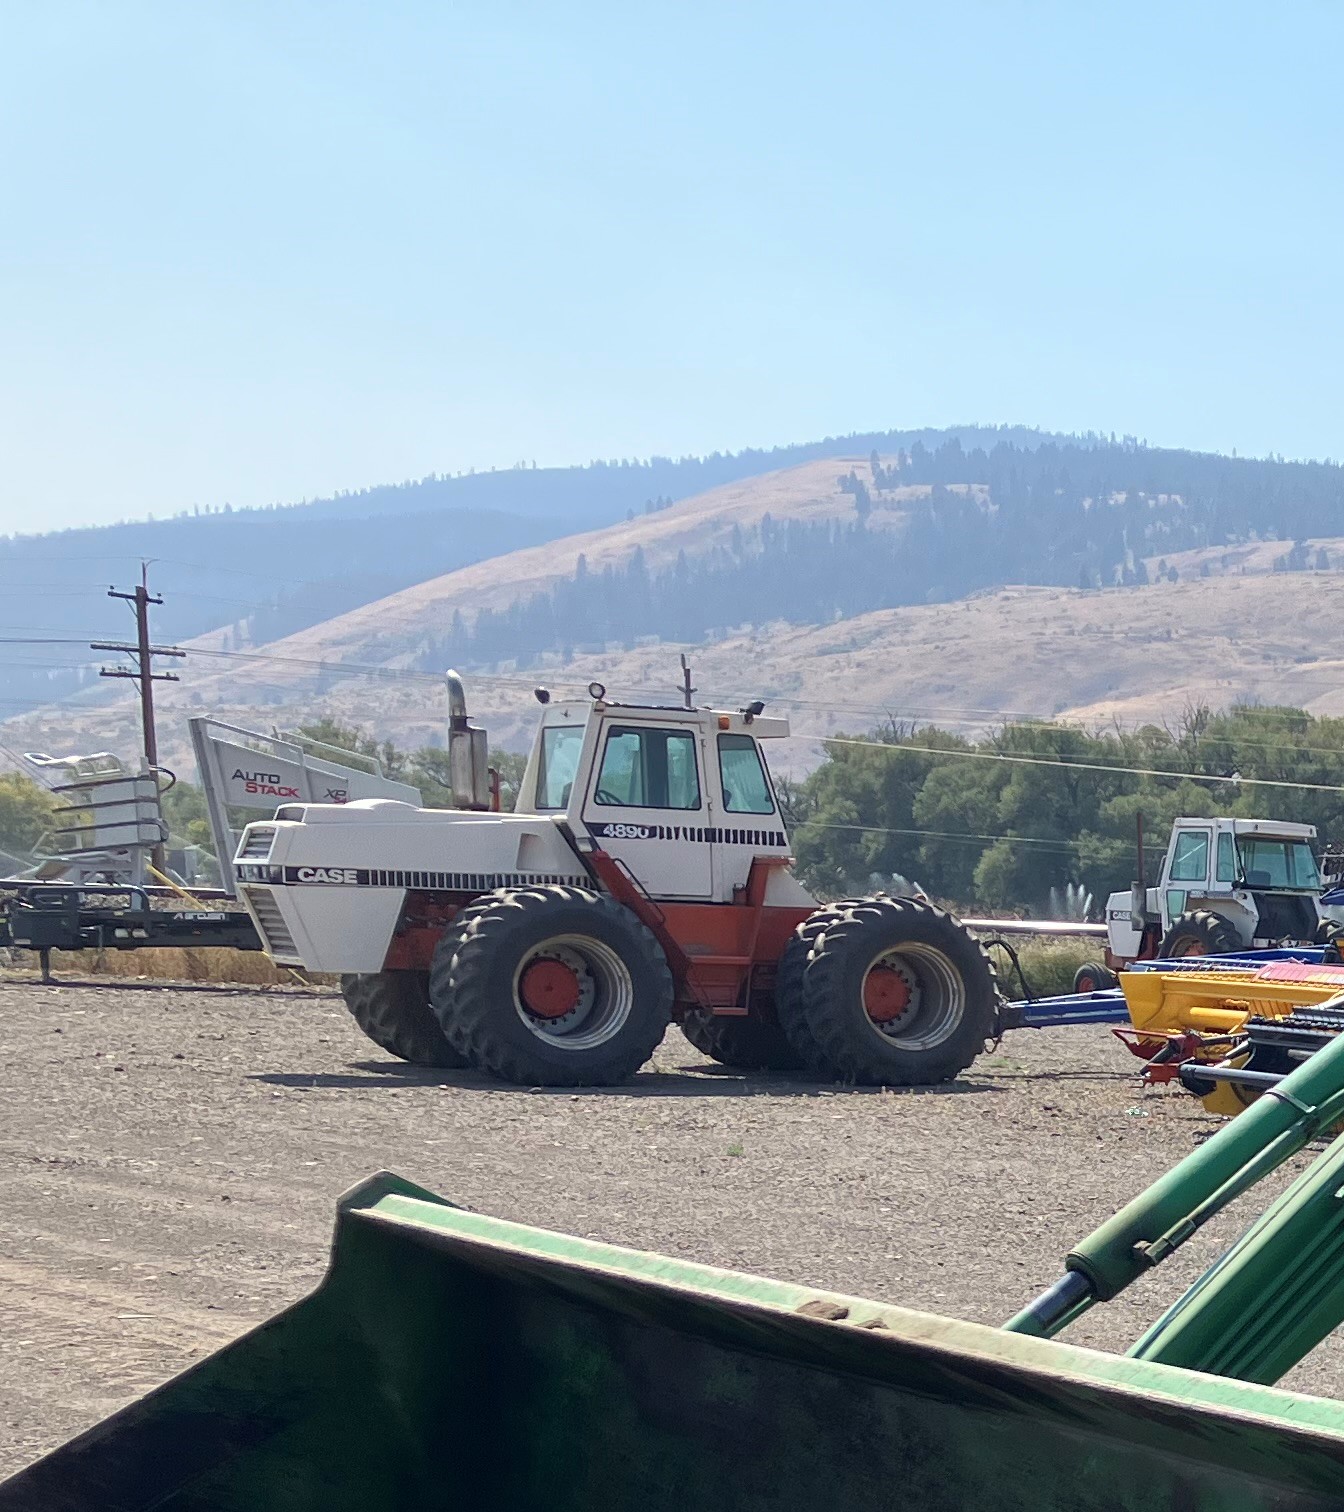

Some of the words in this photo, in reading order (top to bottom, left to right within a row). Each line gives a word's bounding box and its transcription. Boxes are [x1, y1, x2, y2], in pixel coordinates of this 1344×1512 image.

[231, 768, 281, 785] AUTO
[244, 781, 300, 799] STACK
[602, 822, 649, 839] 4890
[296, 867, 358, 885] CASE
[1112, 910, 1131, 920] CASE
